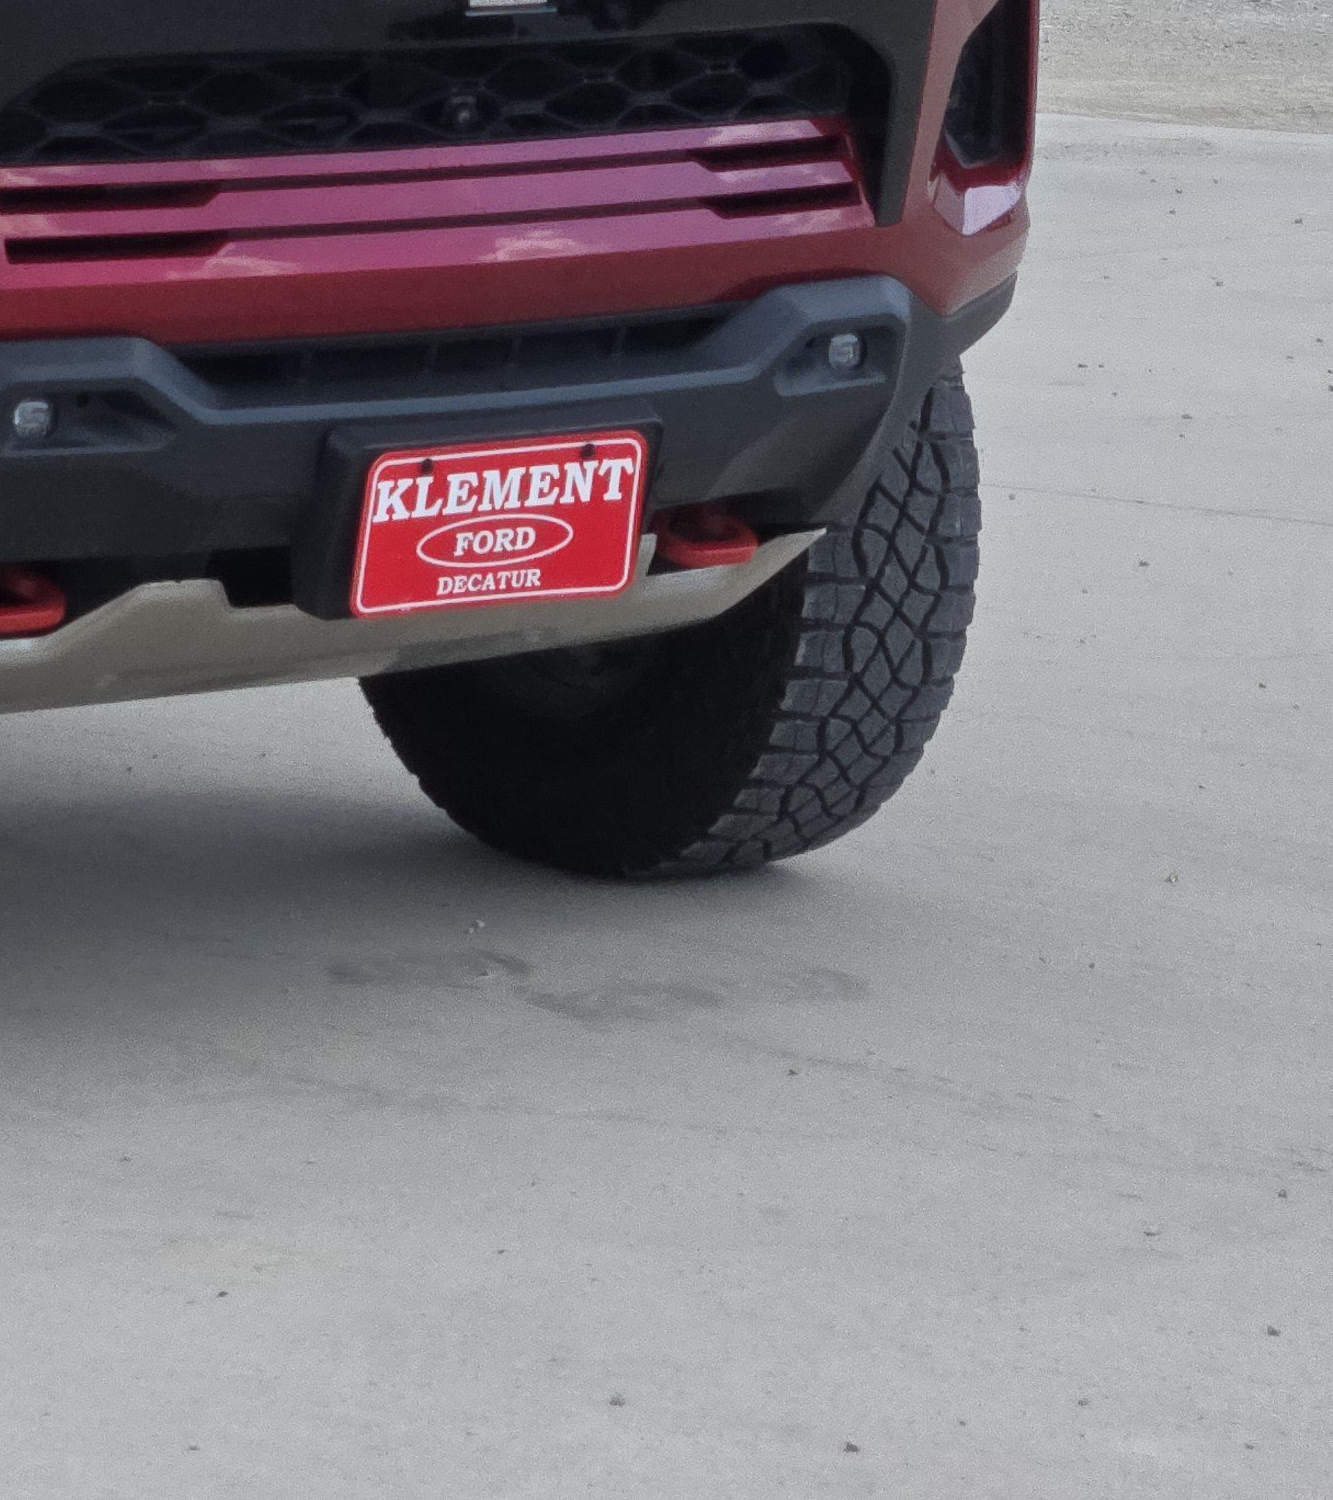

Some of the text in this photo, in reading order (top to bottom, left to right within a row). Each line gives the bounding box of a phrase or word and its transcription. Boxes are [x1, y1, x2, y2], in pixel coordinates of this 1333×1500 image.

[373, 458, 633, 523] KLEMENT
[454, 527, 535, 556] FORD
[437, 569, 541, 596] DECATUR
